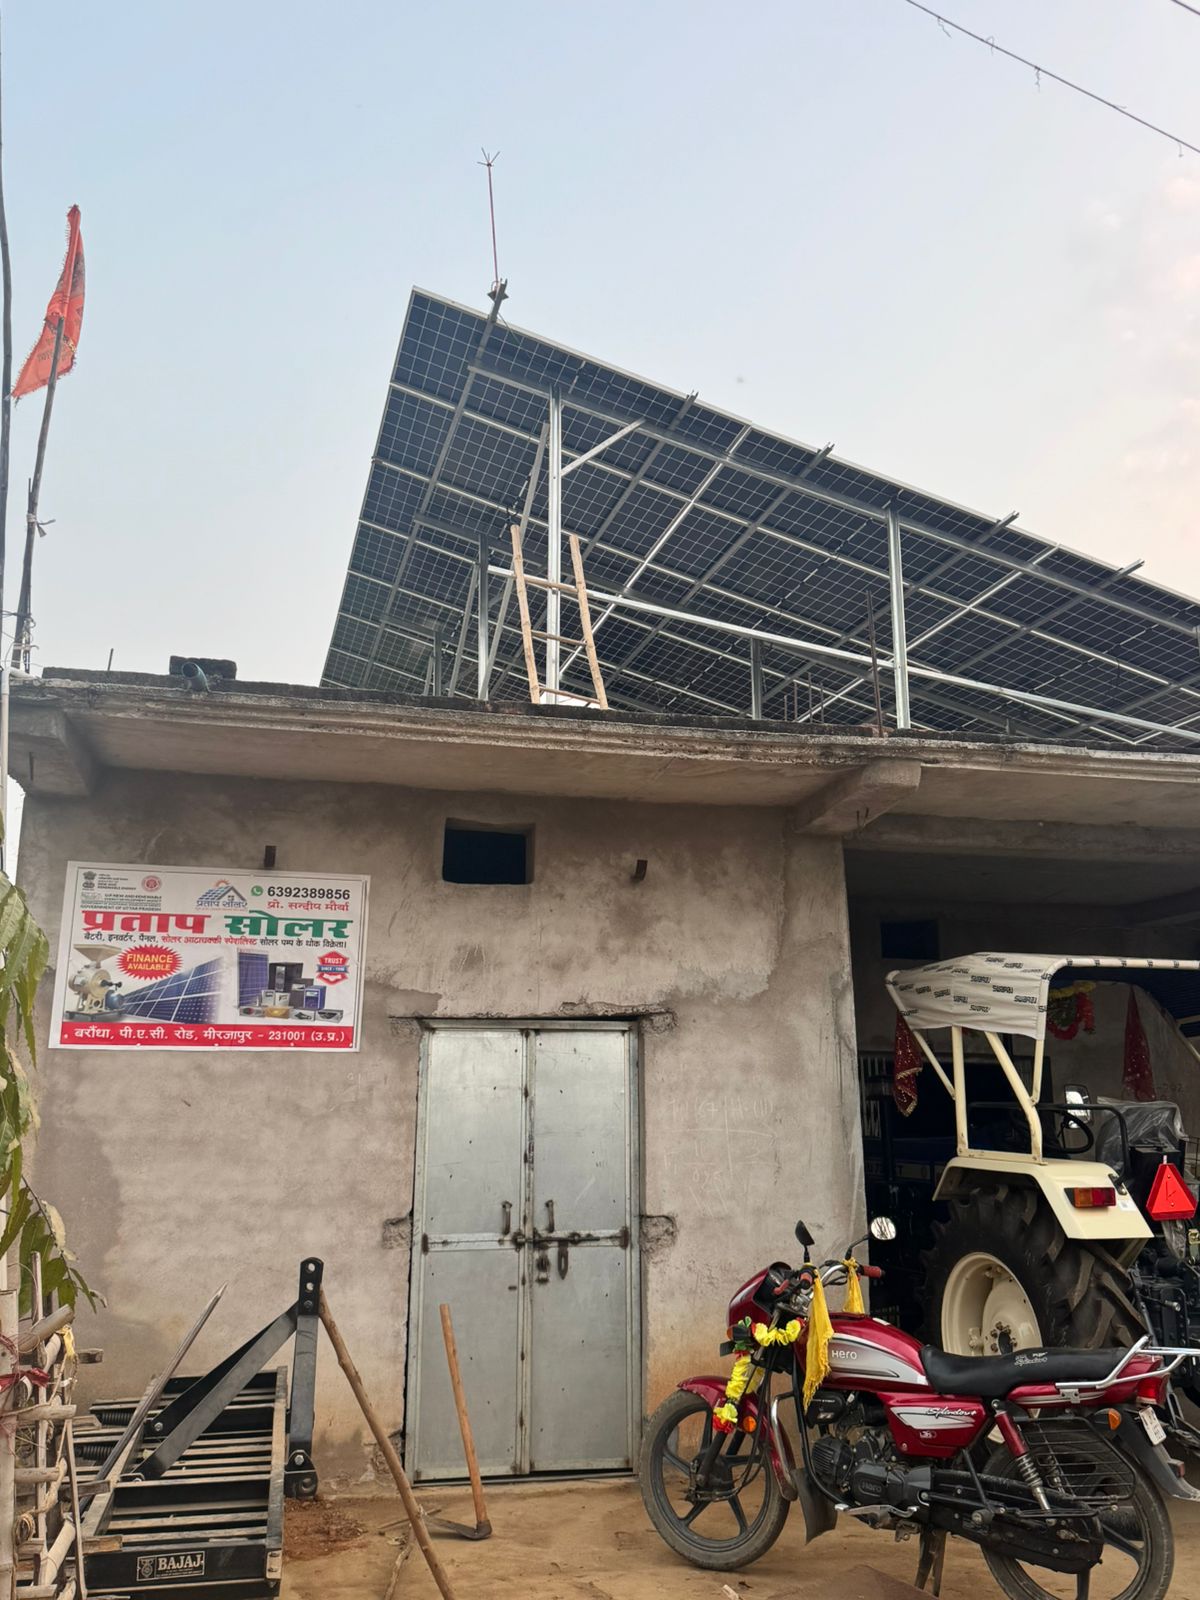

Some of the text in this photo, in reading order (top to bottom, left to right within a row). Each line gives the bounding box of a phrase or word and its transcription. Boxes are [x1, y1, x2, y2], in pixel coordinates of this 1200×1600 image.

[267, 886, 350, 900] 6392389856
[196, 899, 219, 907] प्रताप
[81, 910, 354, 939] प्रताप सोलर
[161, 934, 182, 944] सोलर
[260, 936, 279, 946] सोलर
[295, 937, 303, 947] के
[126, 953, 174, 964] FINANCE
[127, 963, 171, 971] AVAILABLE
[174, 1027, 198, 1041] रोड,
[203, 1027, 253, 1043] मीरजापुर
[268, 1031, 305, 1041] 231001
[157, 1554, 202, 1571] BAJAJ
